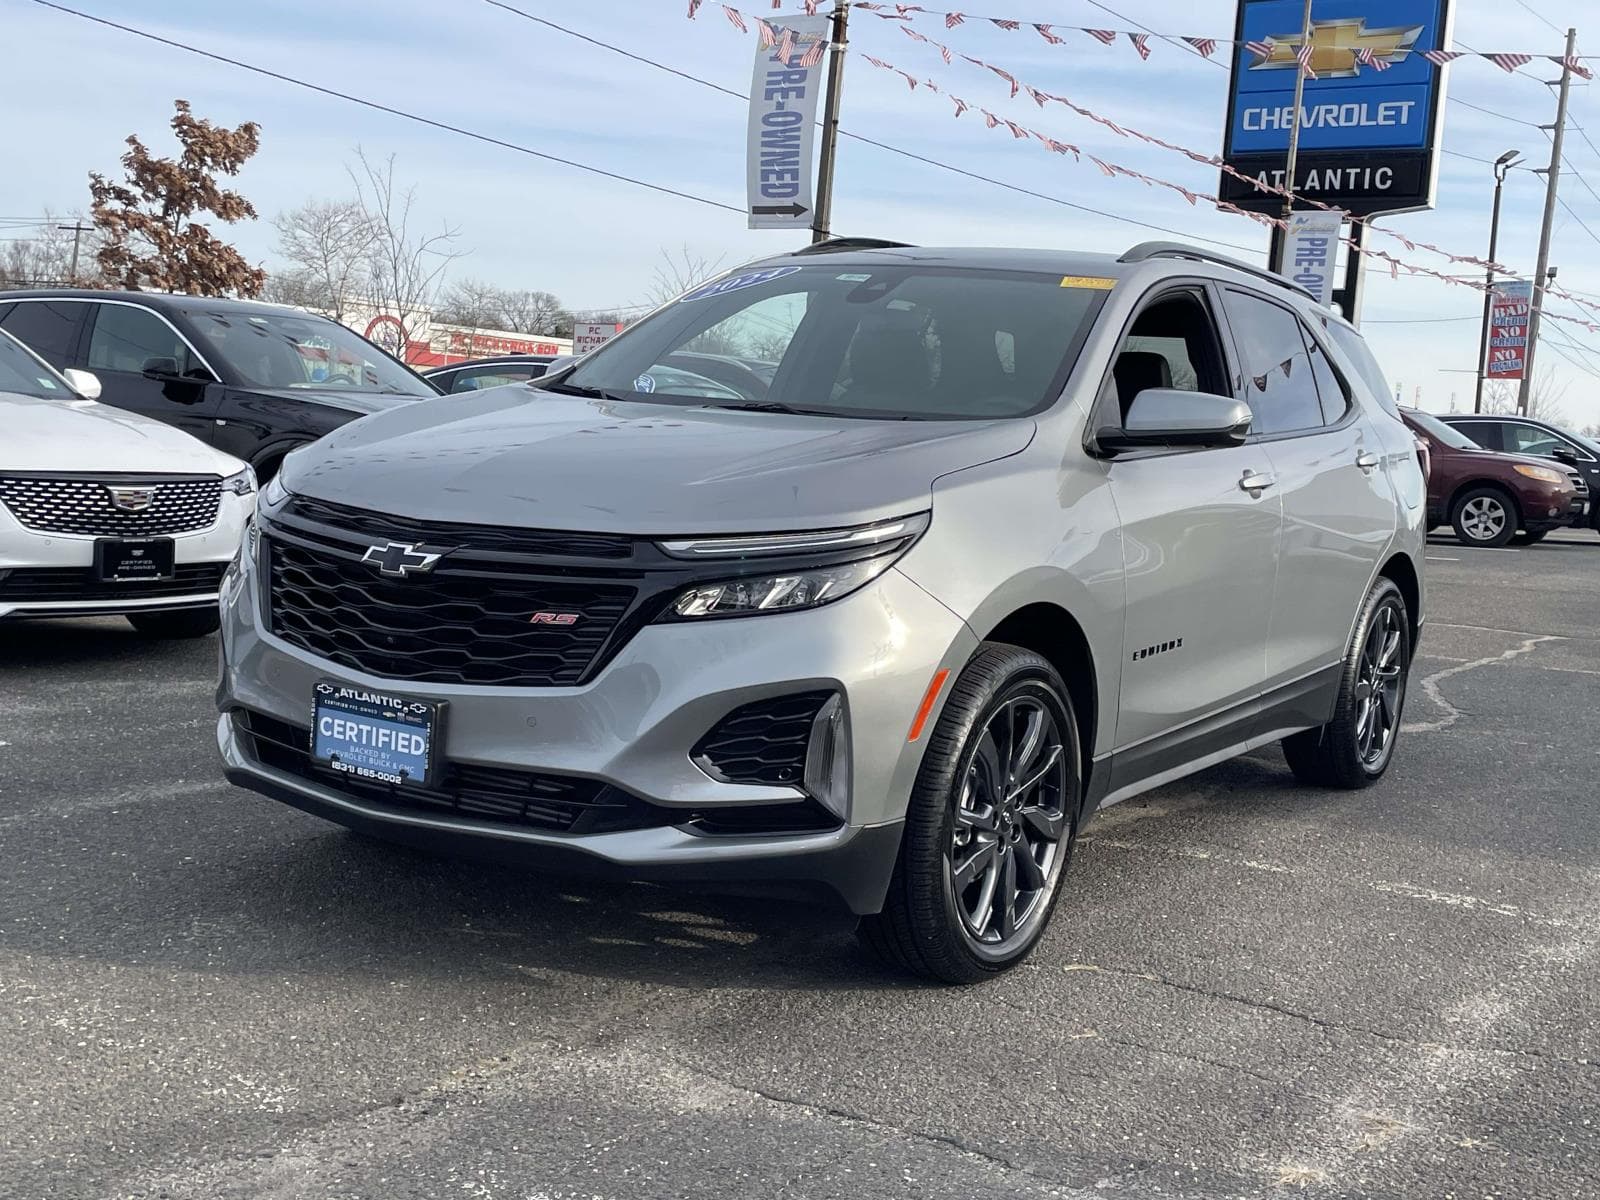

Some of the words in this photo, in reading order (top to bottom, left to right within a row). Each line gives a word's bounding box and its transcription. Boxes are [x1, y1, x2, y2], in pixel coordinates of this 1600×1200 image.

[1243, 101, 1415, 131] CHEVROLET
[759, 54, 809, 198] PRE-OWNED
[1493, 304, 1528, 318] BAD
[1498, 326, 1521, 338] NO
[576, 335, 610, 344] RICHAR
[1492, 337, 1526, 346] CREDIT
[536, 342, 559, 355] SON
[1494, 349, 1517, 361] NO
[530, 612, 580, 625] RS
[1132, 637, 1183, 661] EQUINOX
[339, 687, 402, 709] ATLANTIC
[319, 716, 426, 756] CERTIFIED
[349, 745, 379, 758] BACKED
[380, 749, 391, 760] BY
[326, 747, 369, 764] CHEVROLET
[369, 757, 391, 769] BUICK
[392, 761, 398, 770] &
[399, 763, 415, 774] GMC
